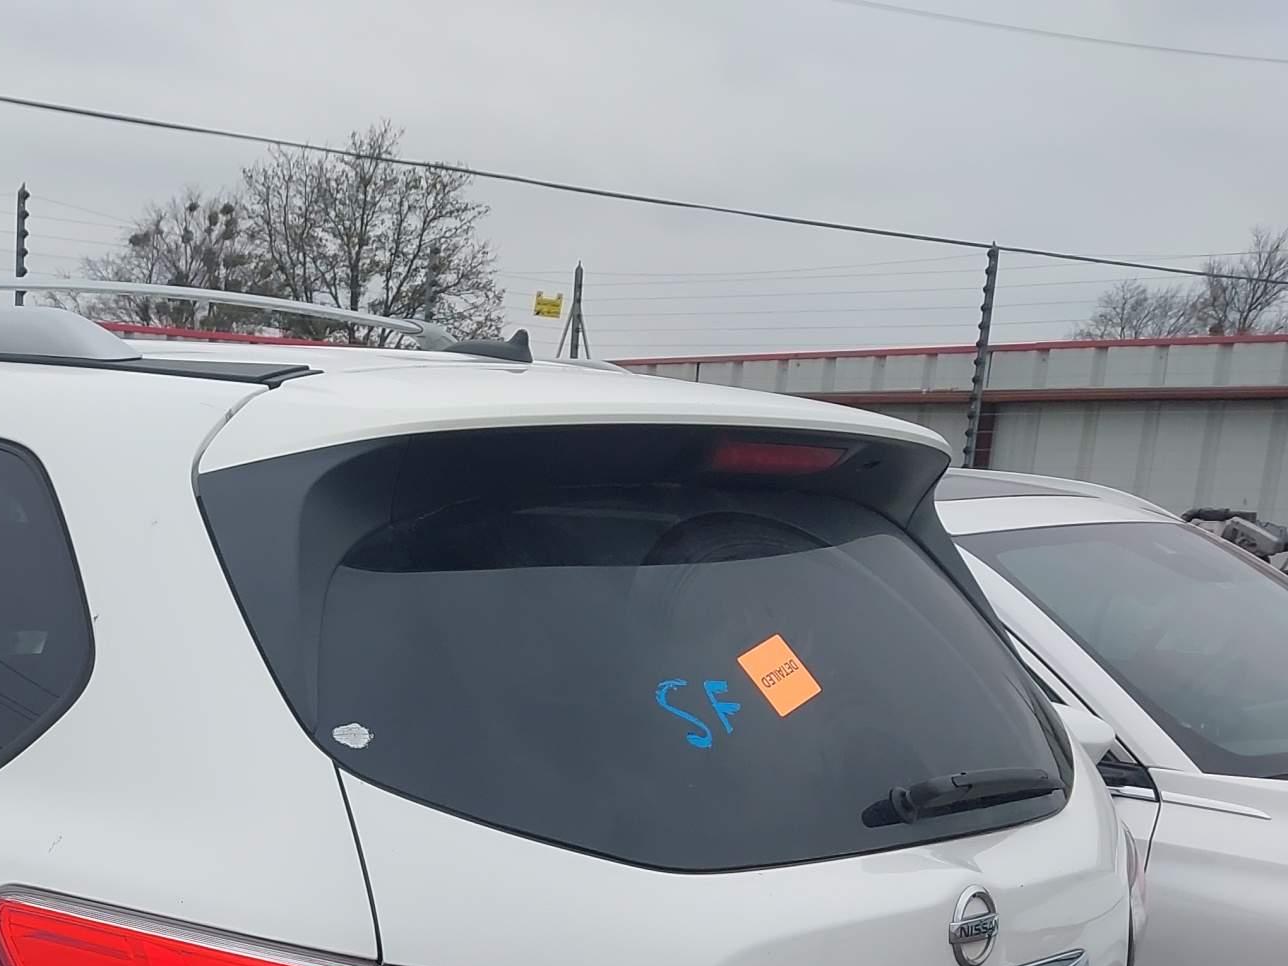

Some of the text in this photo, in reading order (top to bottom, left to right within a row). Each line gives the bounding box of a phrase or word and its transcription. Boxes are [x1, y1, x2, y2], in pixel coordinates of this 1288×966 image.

[761, 658, 799, 689] DETAILED
[655, 678, 742, 749] SF
[959, 918, 999, 938] NISSAN
